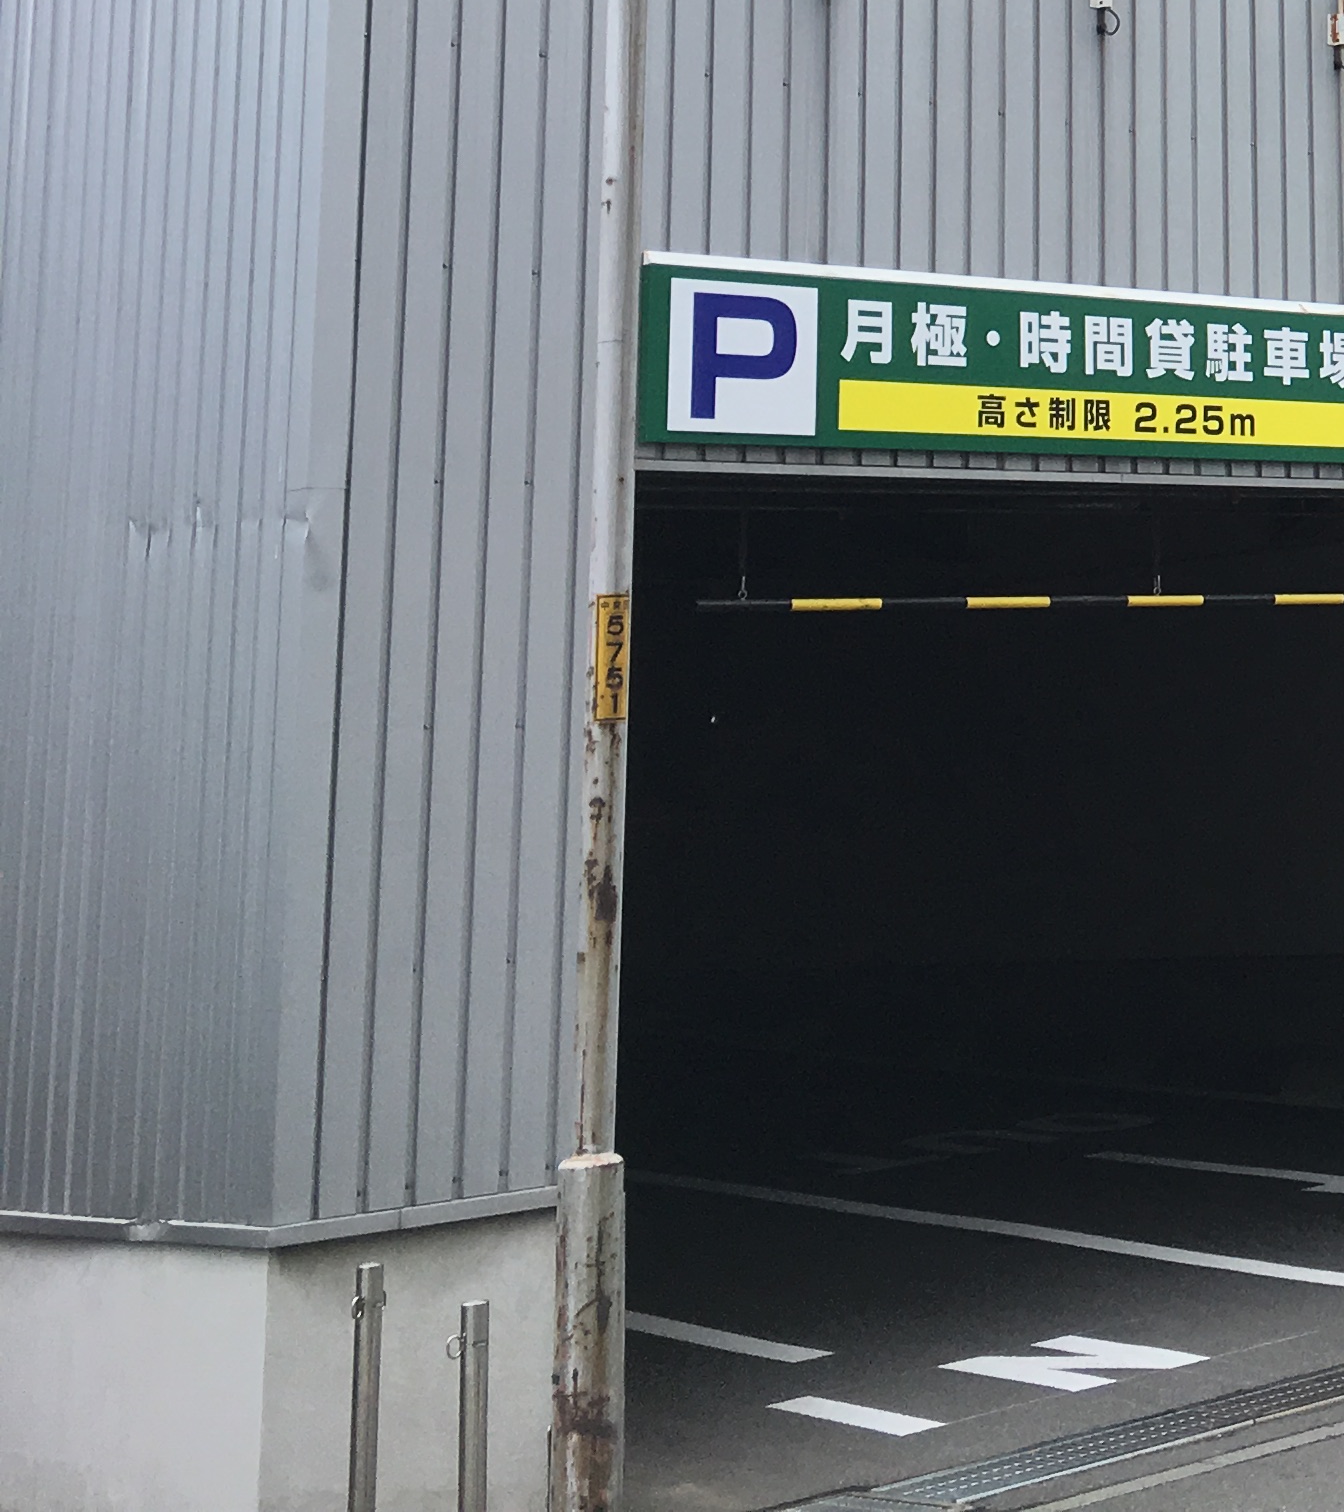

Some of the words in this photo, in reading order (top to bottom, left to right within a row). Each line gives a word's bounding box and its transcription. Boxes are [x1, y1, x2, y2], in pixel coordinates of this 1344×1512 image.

[690, 291, 798, 419] P
[976, 393, 1113, 434] 高さ制限
[1133, 402, 1257, 438] 2.25m
